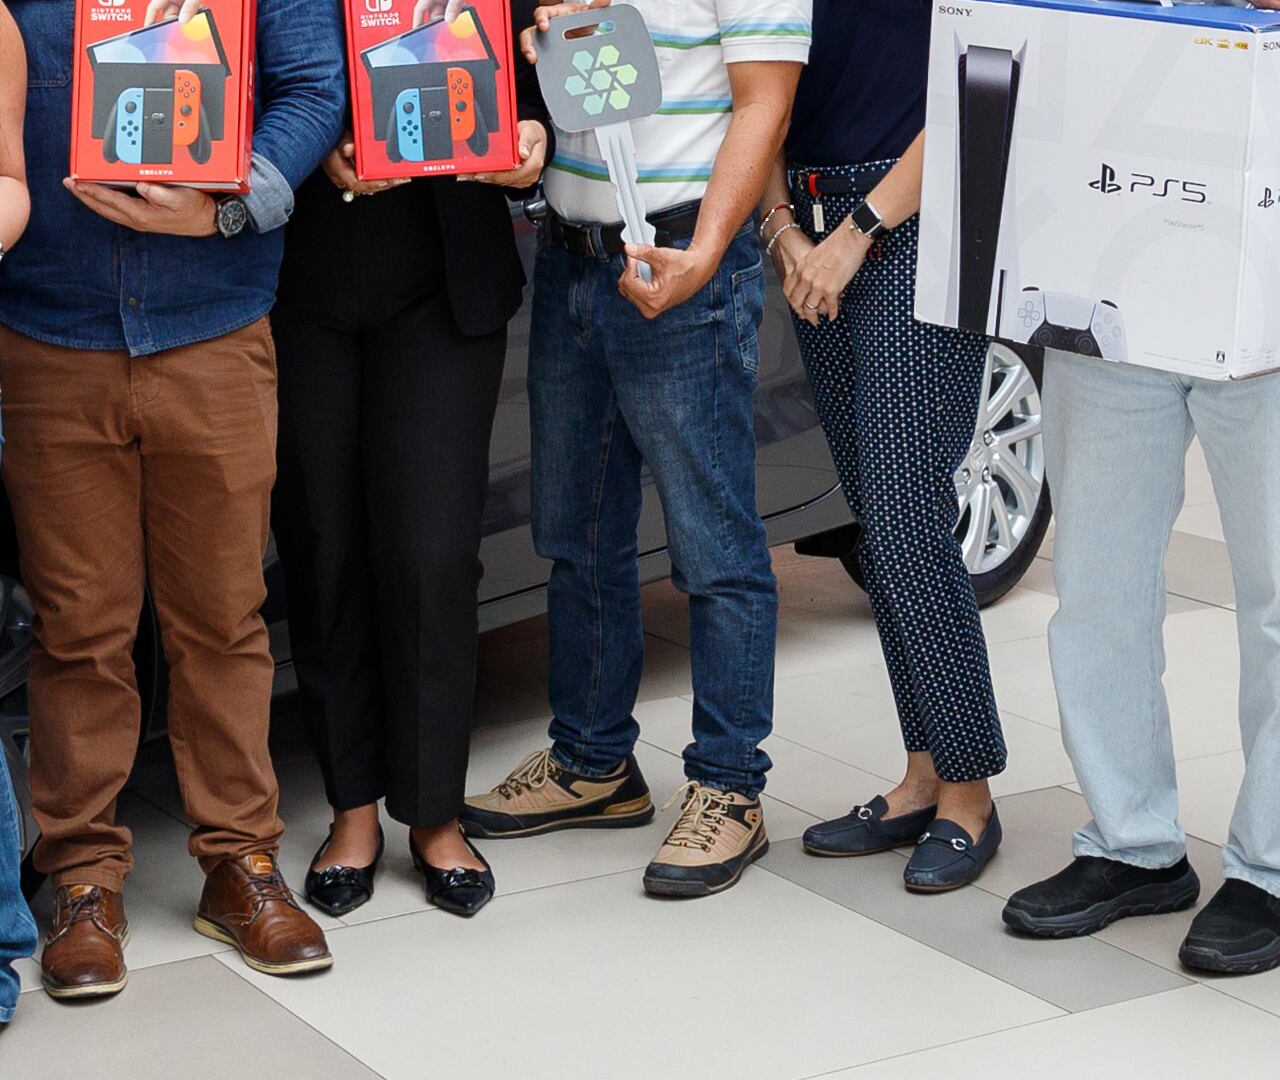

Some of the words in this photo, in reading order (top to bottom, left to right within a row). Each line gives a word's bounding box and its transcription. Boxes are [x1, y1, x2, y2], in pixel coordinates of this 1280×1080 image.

[938, 5, 973, 17] SONY
[91, 13, 132, 21] SWITCH
[361, 18, 400, 27] SWITCH
[1130, 173, 1207, 204] PS5
